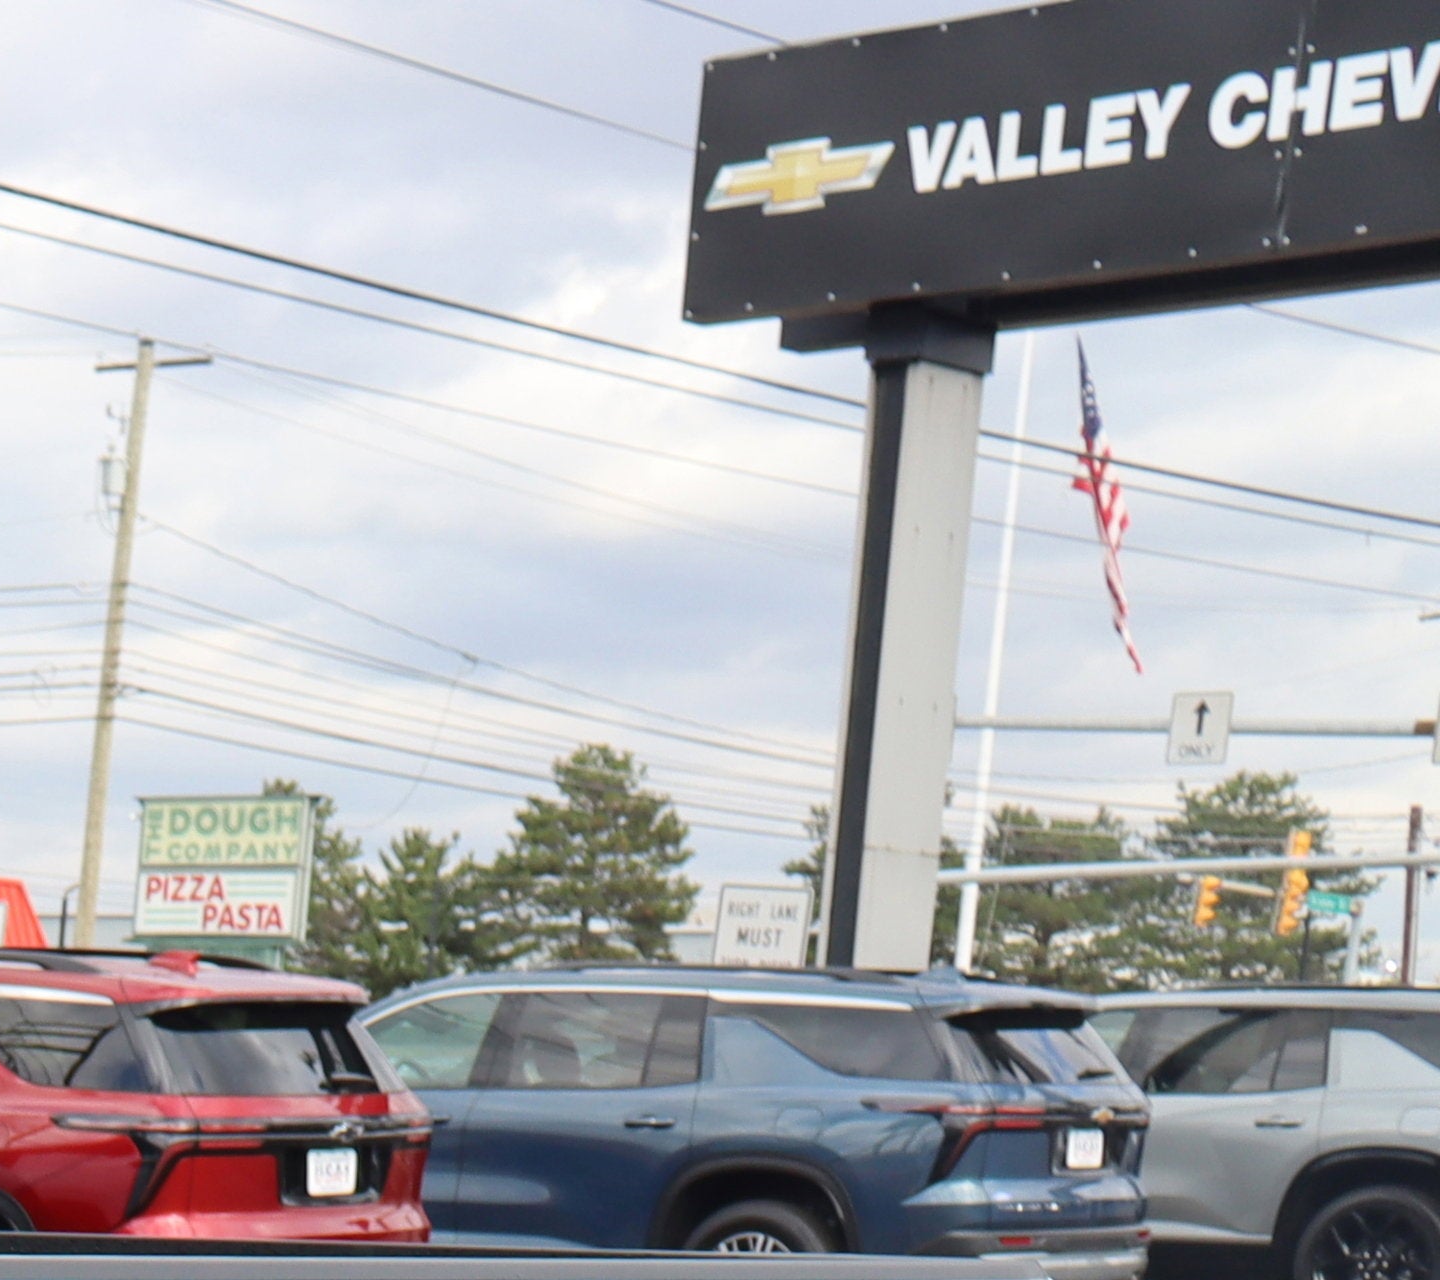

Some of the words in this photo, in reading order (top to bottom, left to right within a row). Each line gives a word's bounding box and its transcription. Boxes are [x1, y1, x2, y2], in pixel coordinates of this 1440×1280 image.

[907, 83, 1191, 193] VALLEY
[1208, 40, 1440, 149] CHEV
[168, 806, 299, 836] DOUGH
[167, 841, 298, 862] COMPANY
[145, 874, 226, 902] PIZZA
[201, 903, 285, 932] PASTA
[736, 925, 784, 948] MUST
